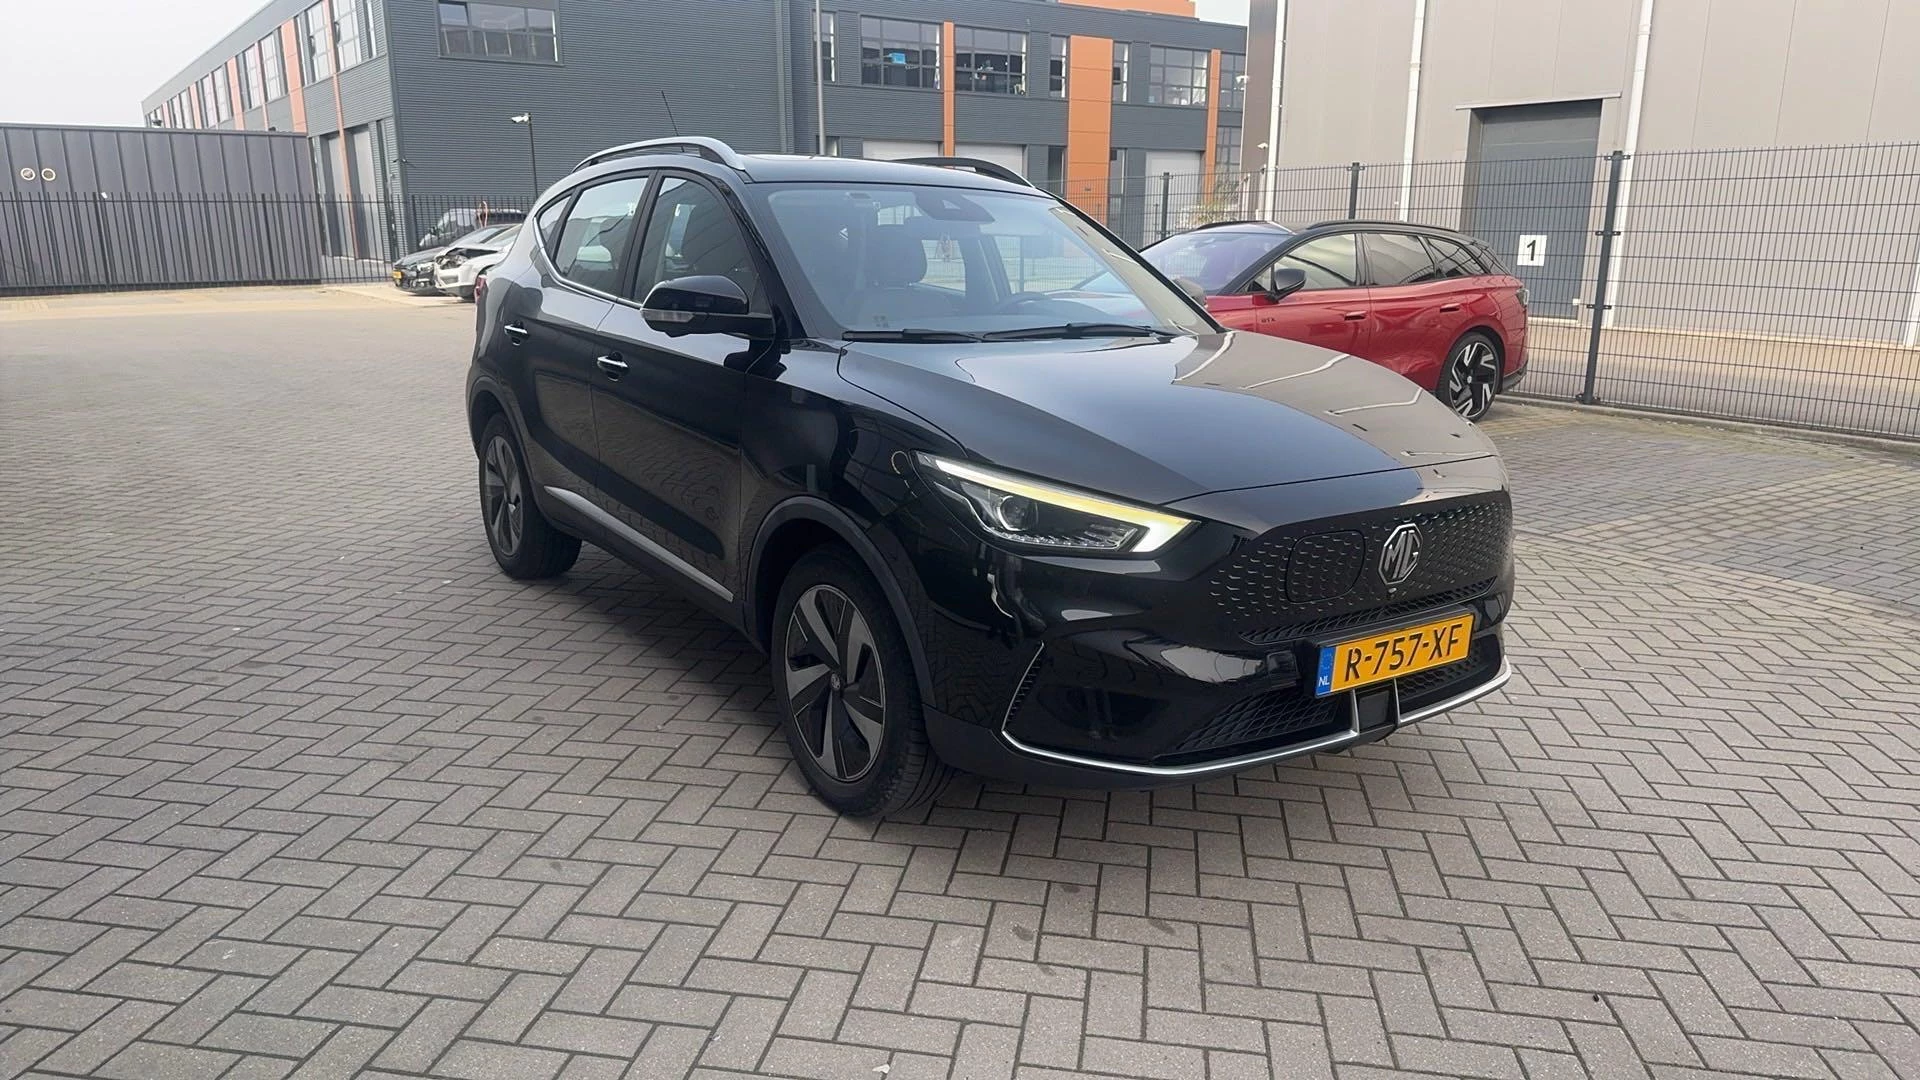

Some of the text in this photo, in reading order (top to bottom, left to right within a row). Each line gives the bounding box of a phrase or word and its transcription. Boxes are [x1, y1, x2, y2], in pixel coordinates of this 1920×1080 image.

[1526, 239, 1536, 261] 1
[1383, 529, 1420, 579] MG
[1318, 623, 1463, 687] NL R-757-XF
